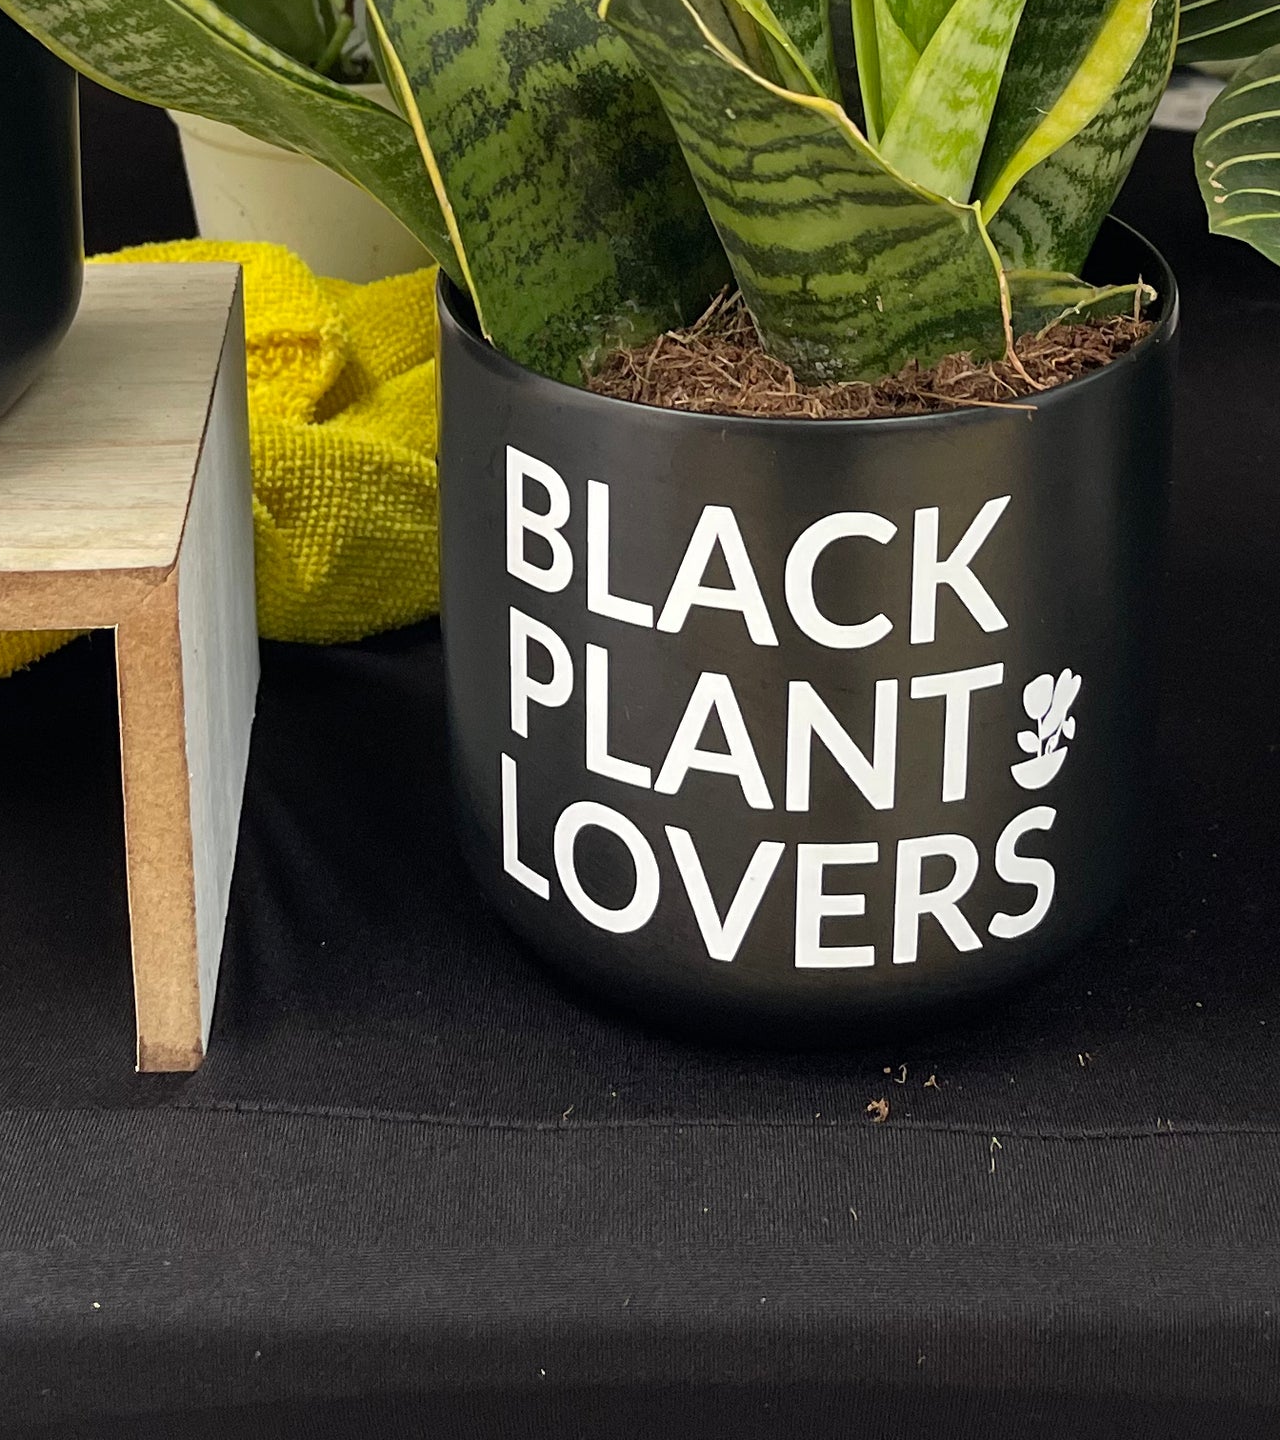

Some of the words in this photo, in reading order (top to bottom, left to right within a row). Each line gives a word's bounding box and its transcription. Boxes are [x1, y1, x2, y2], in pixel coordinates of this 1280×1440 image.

[506, 445, 1012, 649] BLACK
[509, 606, 1004, 812] PLANT
[501, 752, 1057, 969] LOVERS
